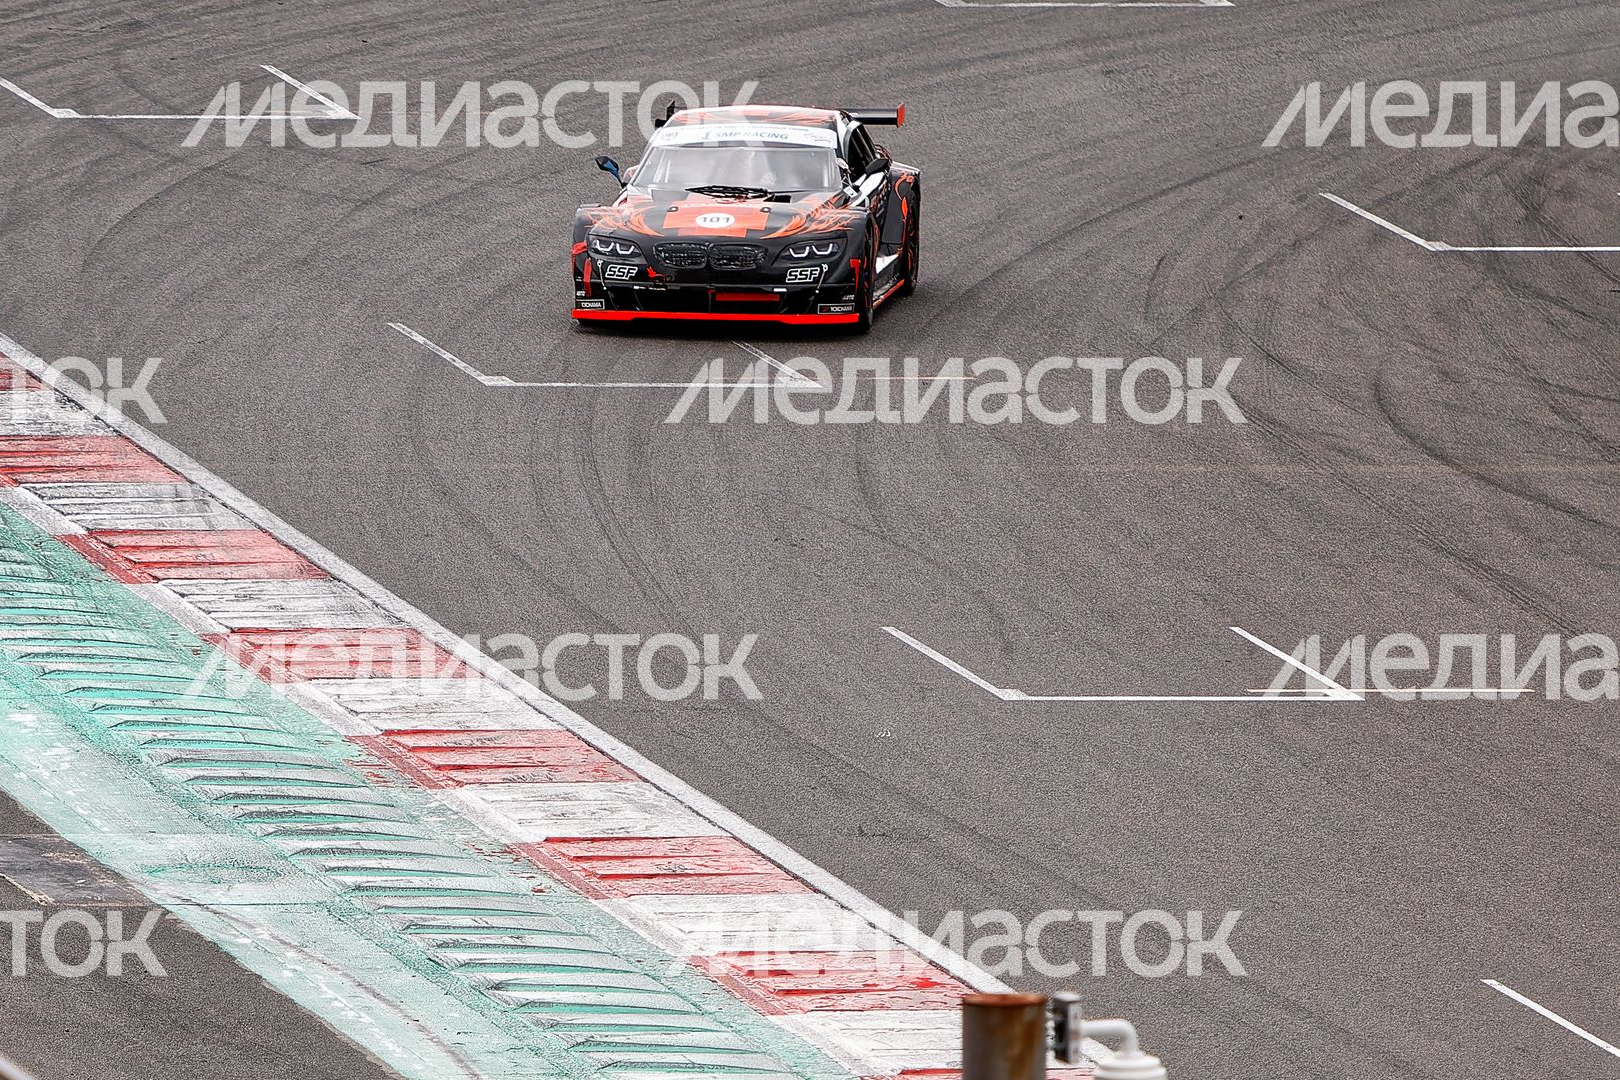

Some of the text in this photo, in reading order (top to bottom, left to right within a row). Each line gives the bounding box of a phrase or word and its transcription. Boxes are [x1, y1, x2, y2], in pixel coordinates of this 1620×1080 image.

[700, 216, 731, 224] 101
[605, 264, 638, 280] SSF
[785, 267, 820, 283] SSF
